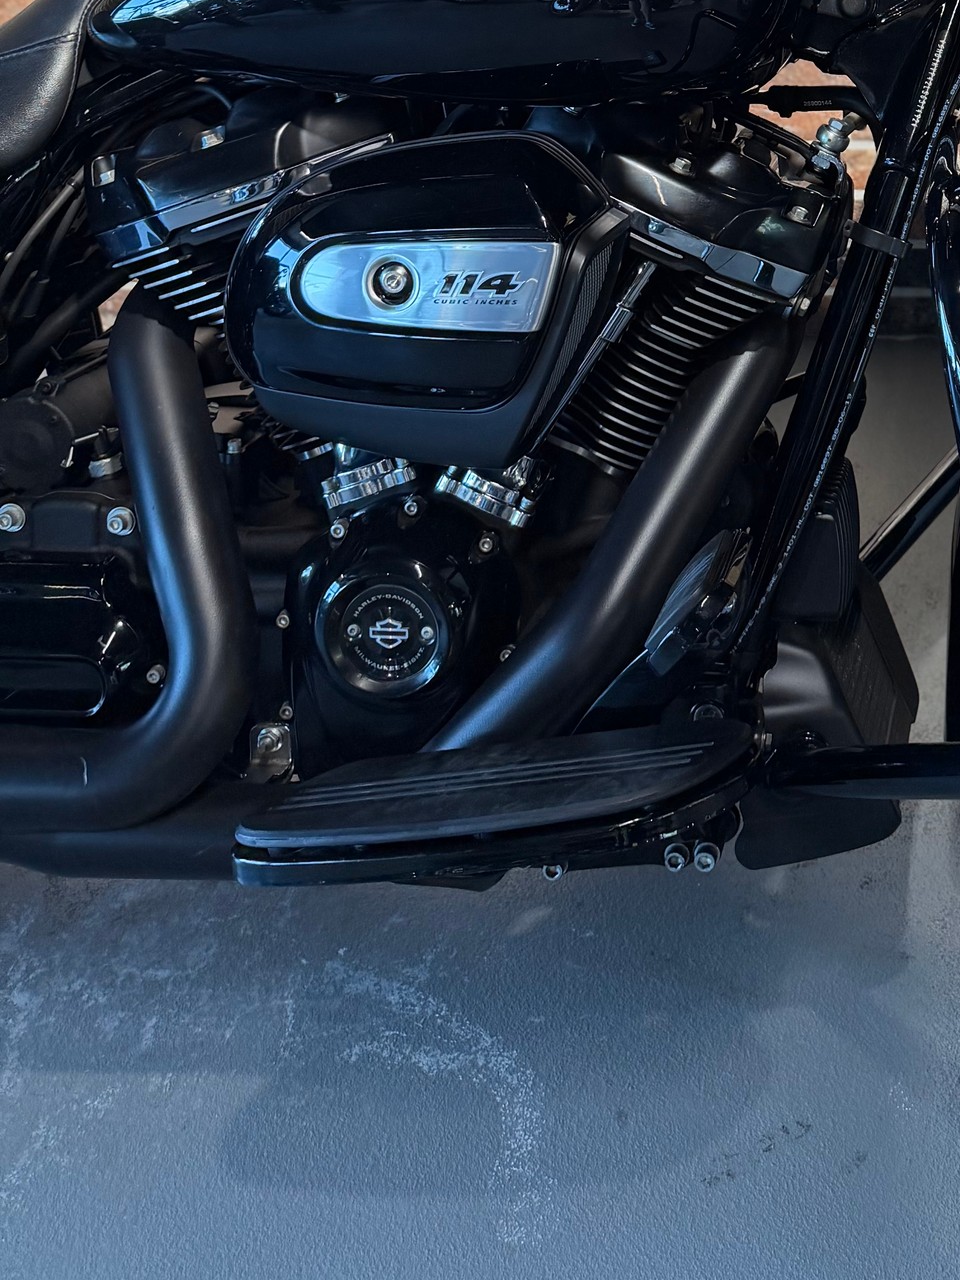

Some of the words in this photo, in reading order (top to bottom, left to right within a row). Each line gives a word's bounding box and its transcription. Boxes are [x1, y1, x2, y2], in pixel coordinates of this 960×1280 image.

[435, 270, 526, 297] 114
[433, 298, 469, 306] CUBIC
[474, 298, 518, 306] INCHES
[353, 593, 424, 619] HARLEY-DAVIDSON
[354, 645, 425, 671] MILWAUKEE-EIGHT
